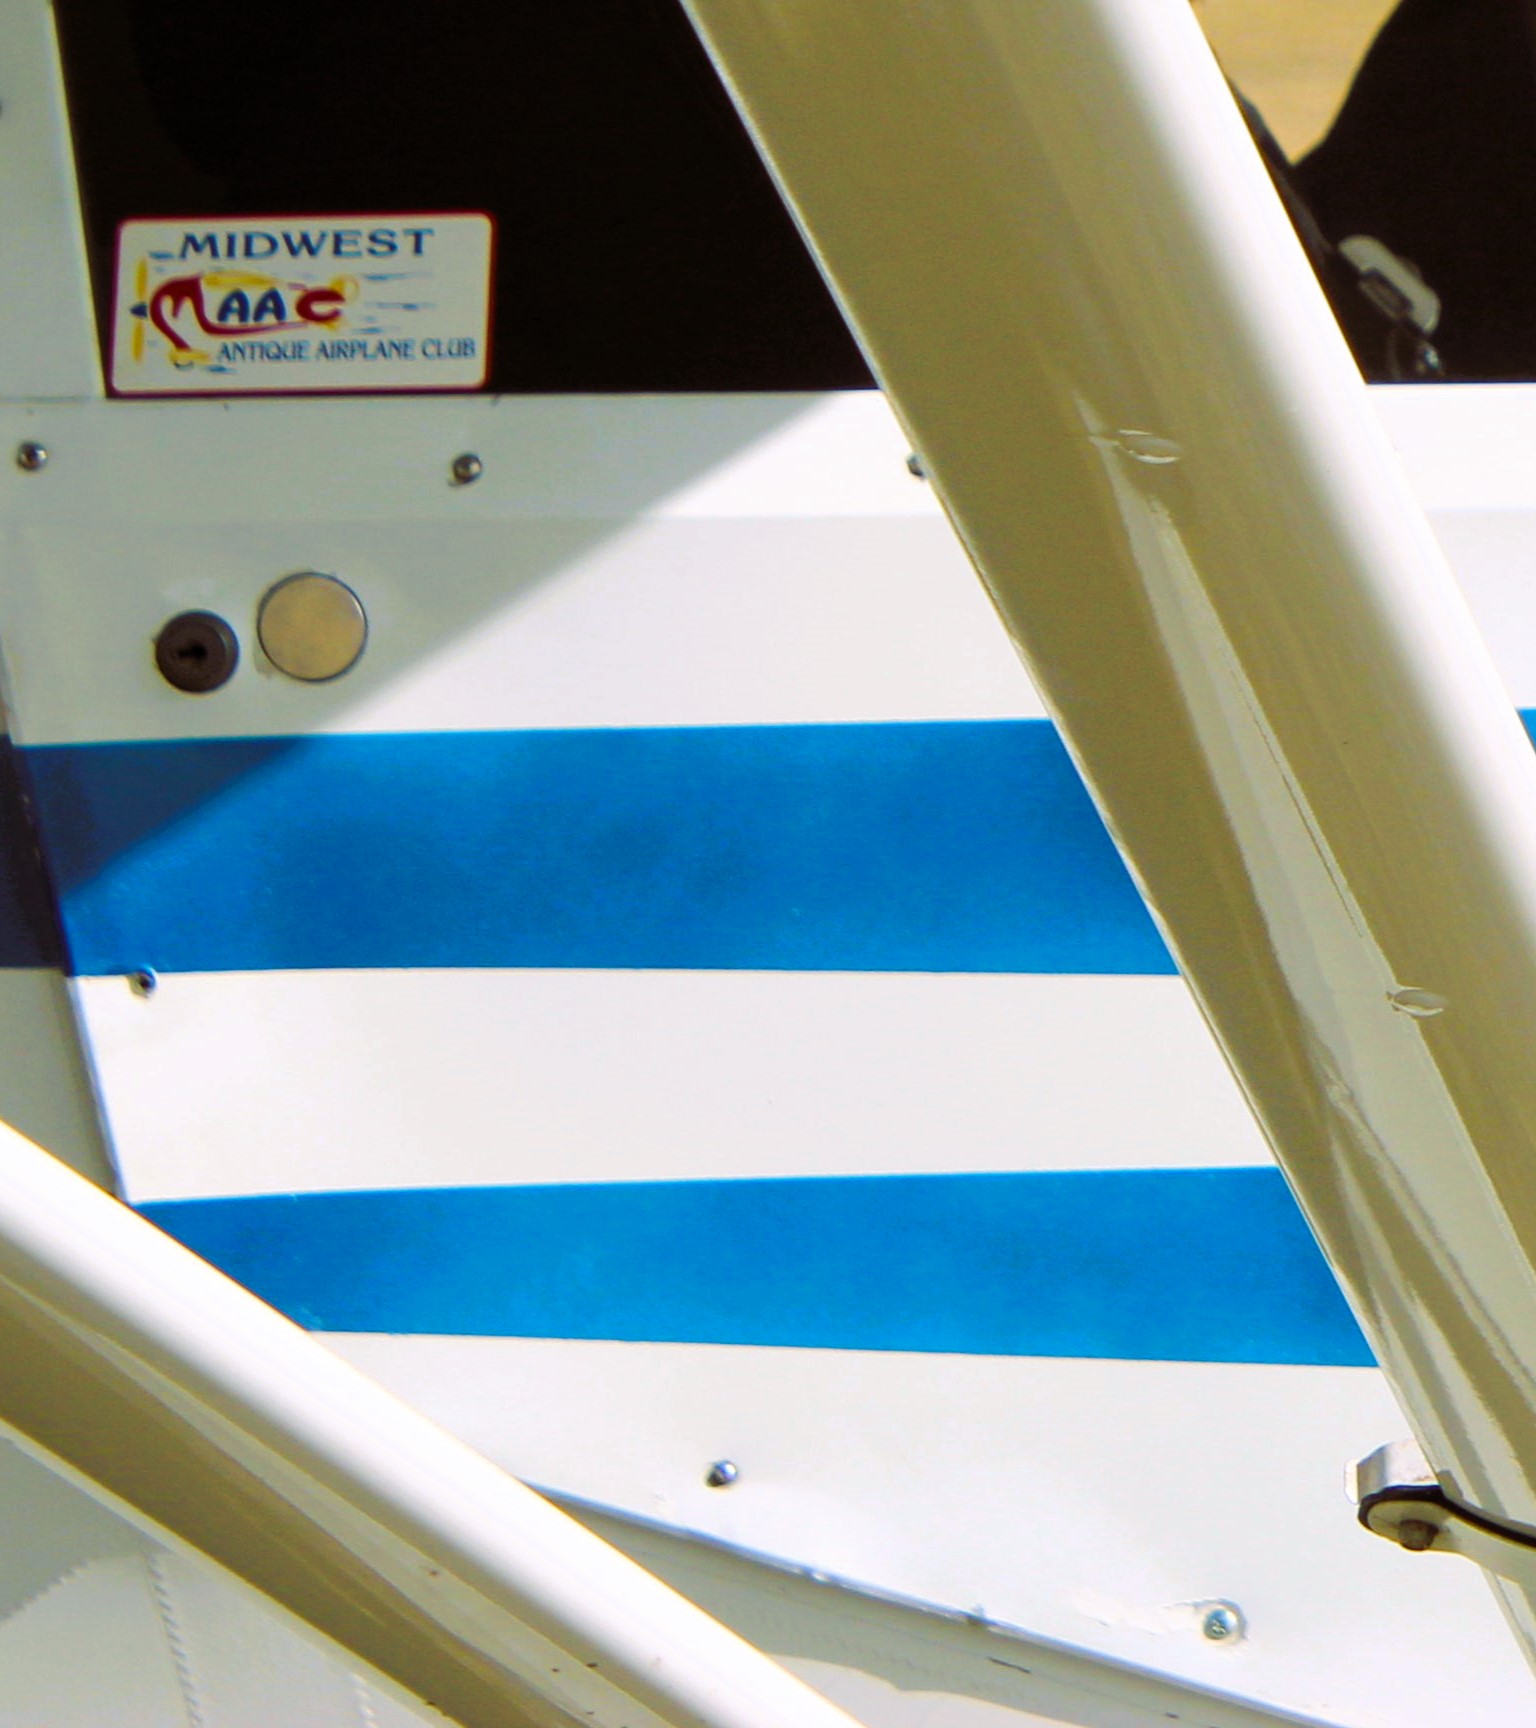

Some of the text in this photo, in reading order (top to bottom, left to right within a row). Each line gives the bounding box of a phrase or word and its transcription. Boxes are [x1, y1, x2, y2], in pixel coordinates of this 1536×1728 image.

[178, 228, 436, 260] MIDWEST
[217, 337, 476, 363] ANTIQUE AIRPLANE CLUB
